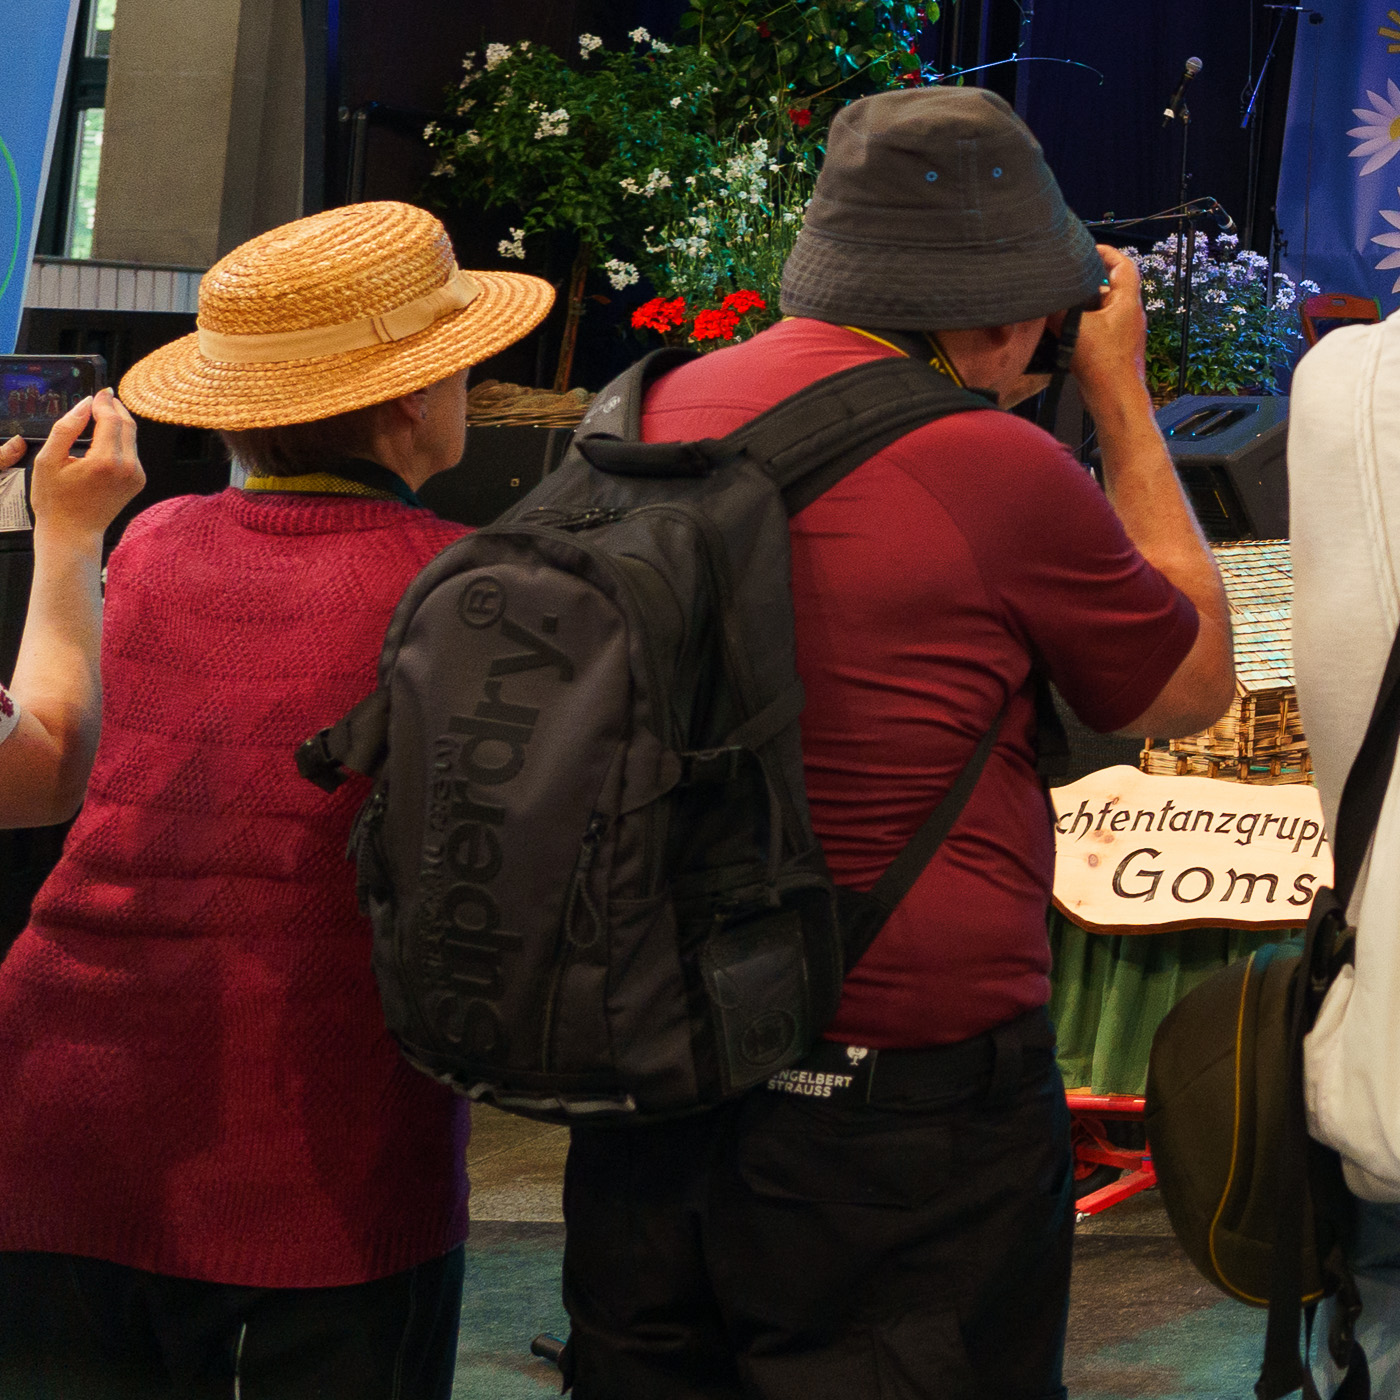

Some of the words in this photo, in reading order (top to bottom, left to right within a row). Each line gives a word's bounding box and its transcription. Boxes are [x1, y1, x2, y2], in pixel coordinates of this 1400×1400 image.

[1111, 847, 1318, 906] Goms
[767, 1079, 832, 1098] STRAUSS
[774, 1070, 853, 1088] NGELBERT
